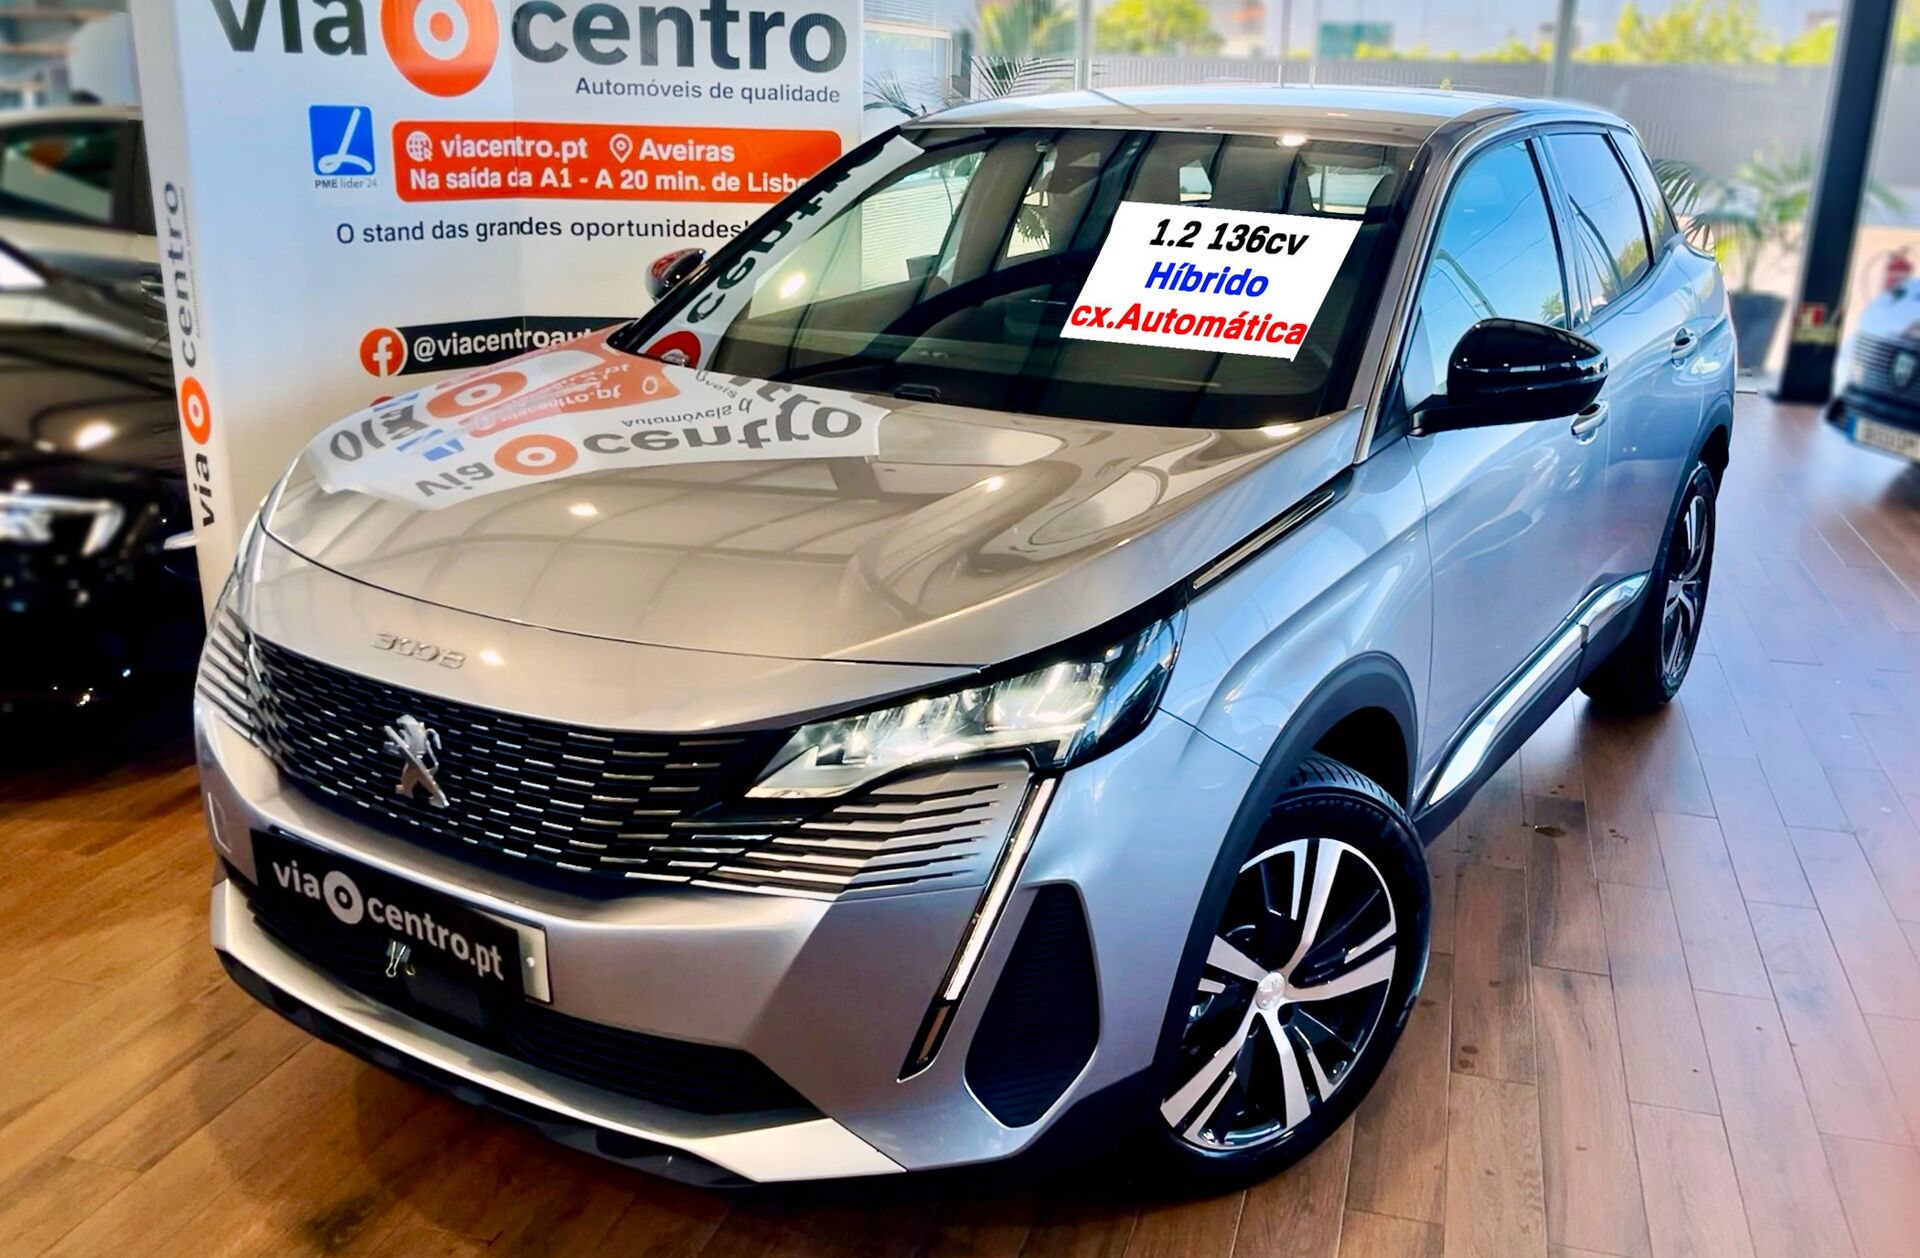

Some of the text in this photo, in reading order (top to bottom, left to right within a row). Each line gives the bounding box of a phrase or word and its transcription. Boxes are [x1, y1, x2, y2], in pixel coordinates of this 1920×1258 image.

[511, 0, 847, 73] centro
[575, 77, 841, 104] Automóveis de qualidade
[440, 133, 736, 163] viacentro.pt Aveiras
[314, 178, 338, 189] PME
[409, 167, 440, 190] Na
[446, 165, 502, 190] saída
[507, 166, 533, 188] da
[540, 166, 573, 188] A1
[594, 168, 614, 189] A
[619, 169, 649, 190] 20
[655, 171, 706, 191] min.
[711, 171, 741, 192] de
[336, 222, 355, 244] O
[362, 221, 424, 243] stand
[431, 219, 469, 240] das
[475, 216, 563, 243] grandes
[163, 182, 197, 368] centro
[193, 453, 215, 527] via
[371, 632, 467, 669] 3008
[272, 859, 504, 981] via centro.pt
